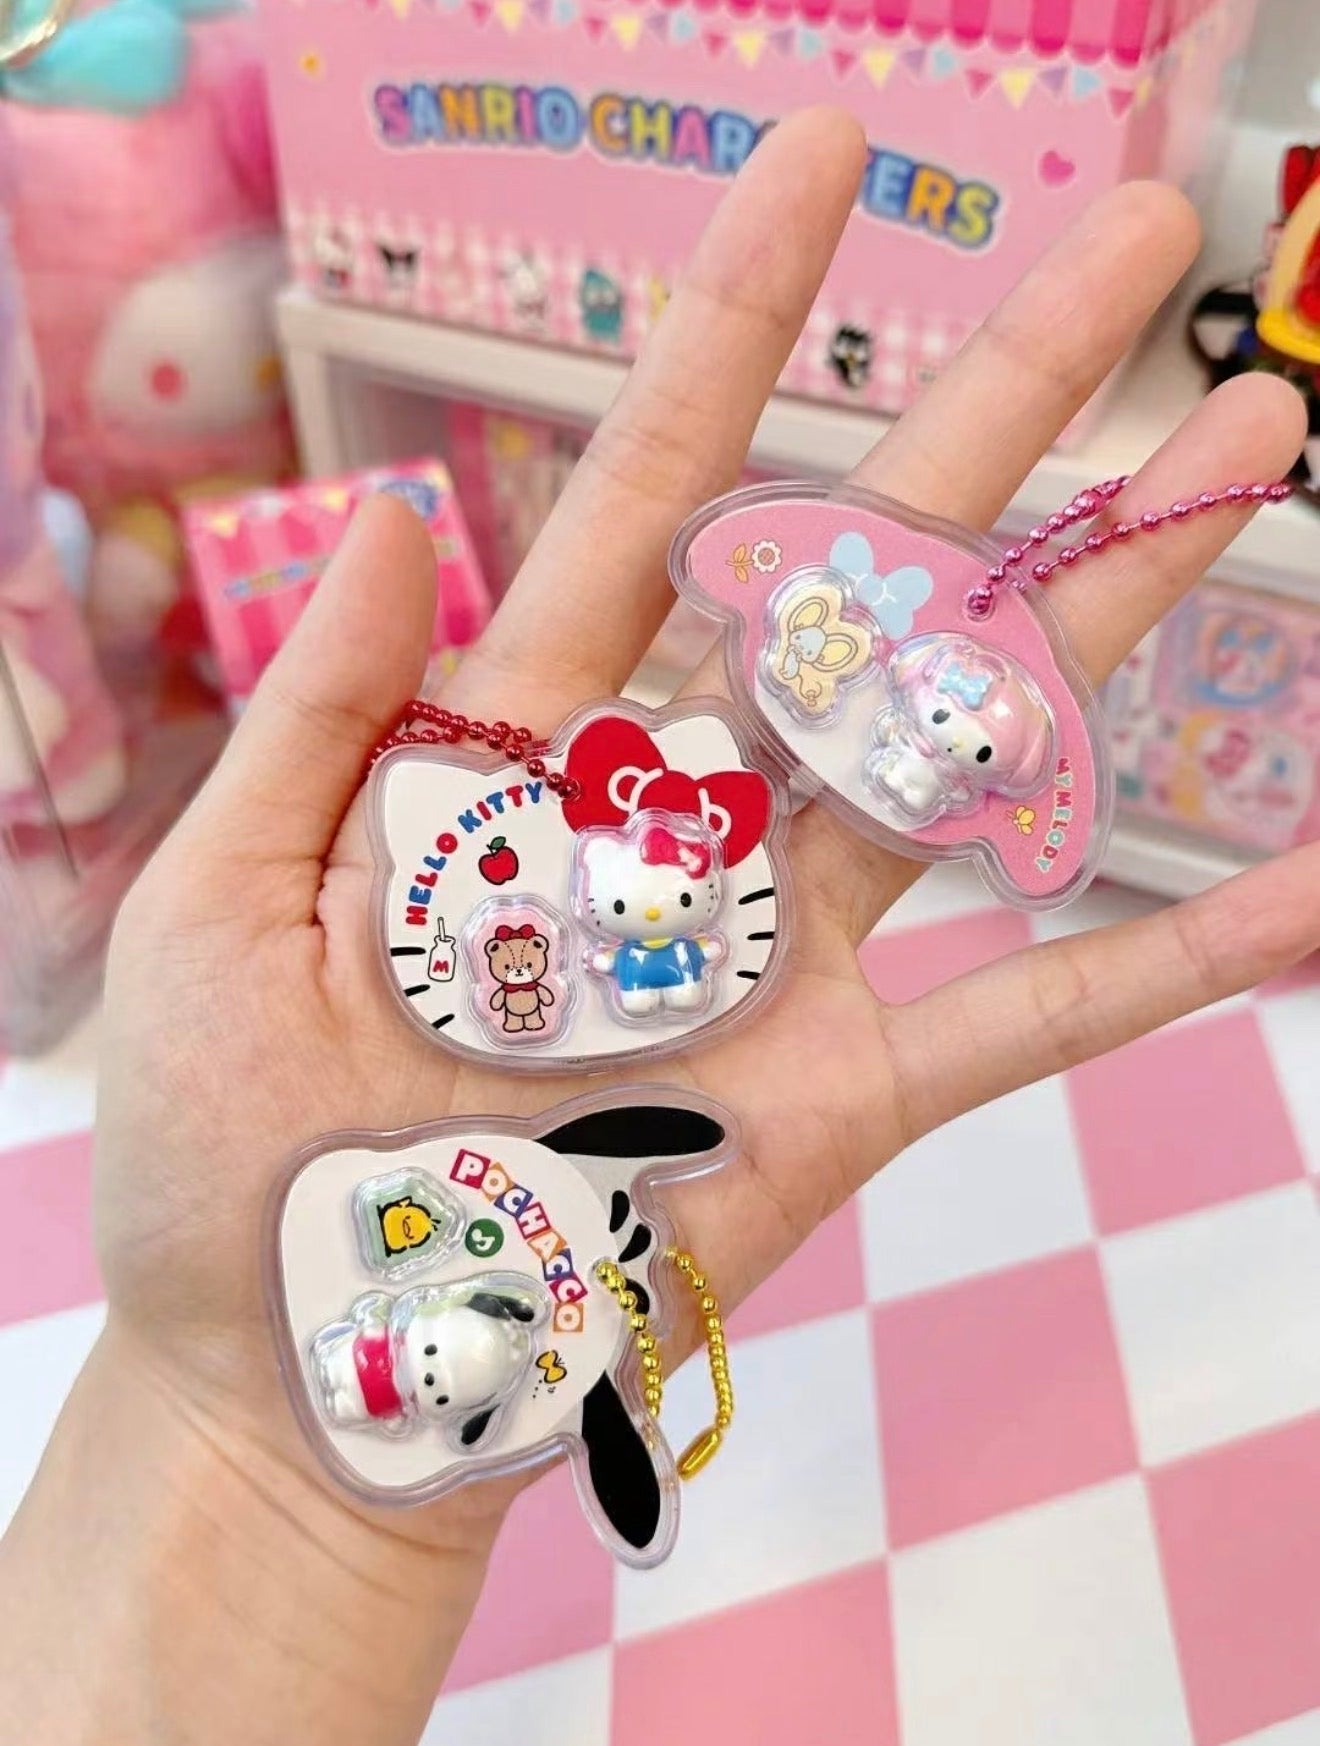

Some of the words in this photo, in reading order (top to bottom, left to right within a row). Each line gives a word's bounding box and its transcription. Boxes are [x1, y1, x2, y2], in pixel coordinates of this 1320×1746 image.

[374, 83, 582, 148] SANRIO
[590, 93, 1000, 249] CHARERS
[1055, 757, 1073, 787] MY
[405, 832, 458, 925] HELLO
[458, 781, 543, 833] KITTY
[1035, 791, 1073, 872] MELODY
[432, 960, 449, 973] M
[450, 1149, 588, 1332] POCHACCO
